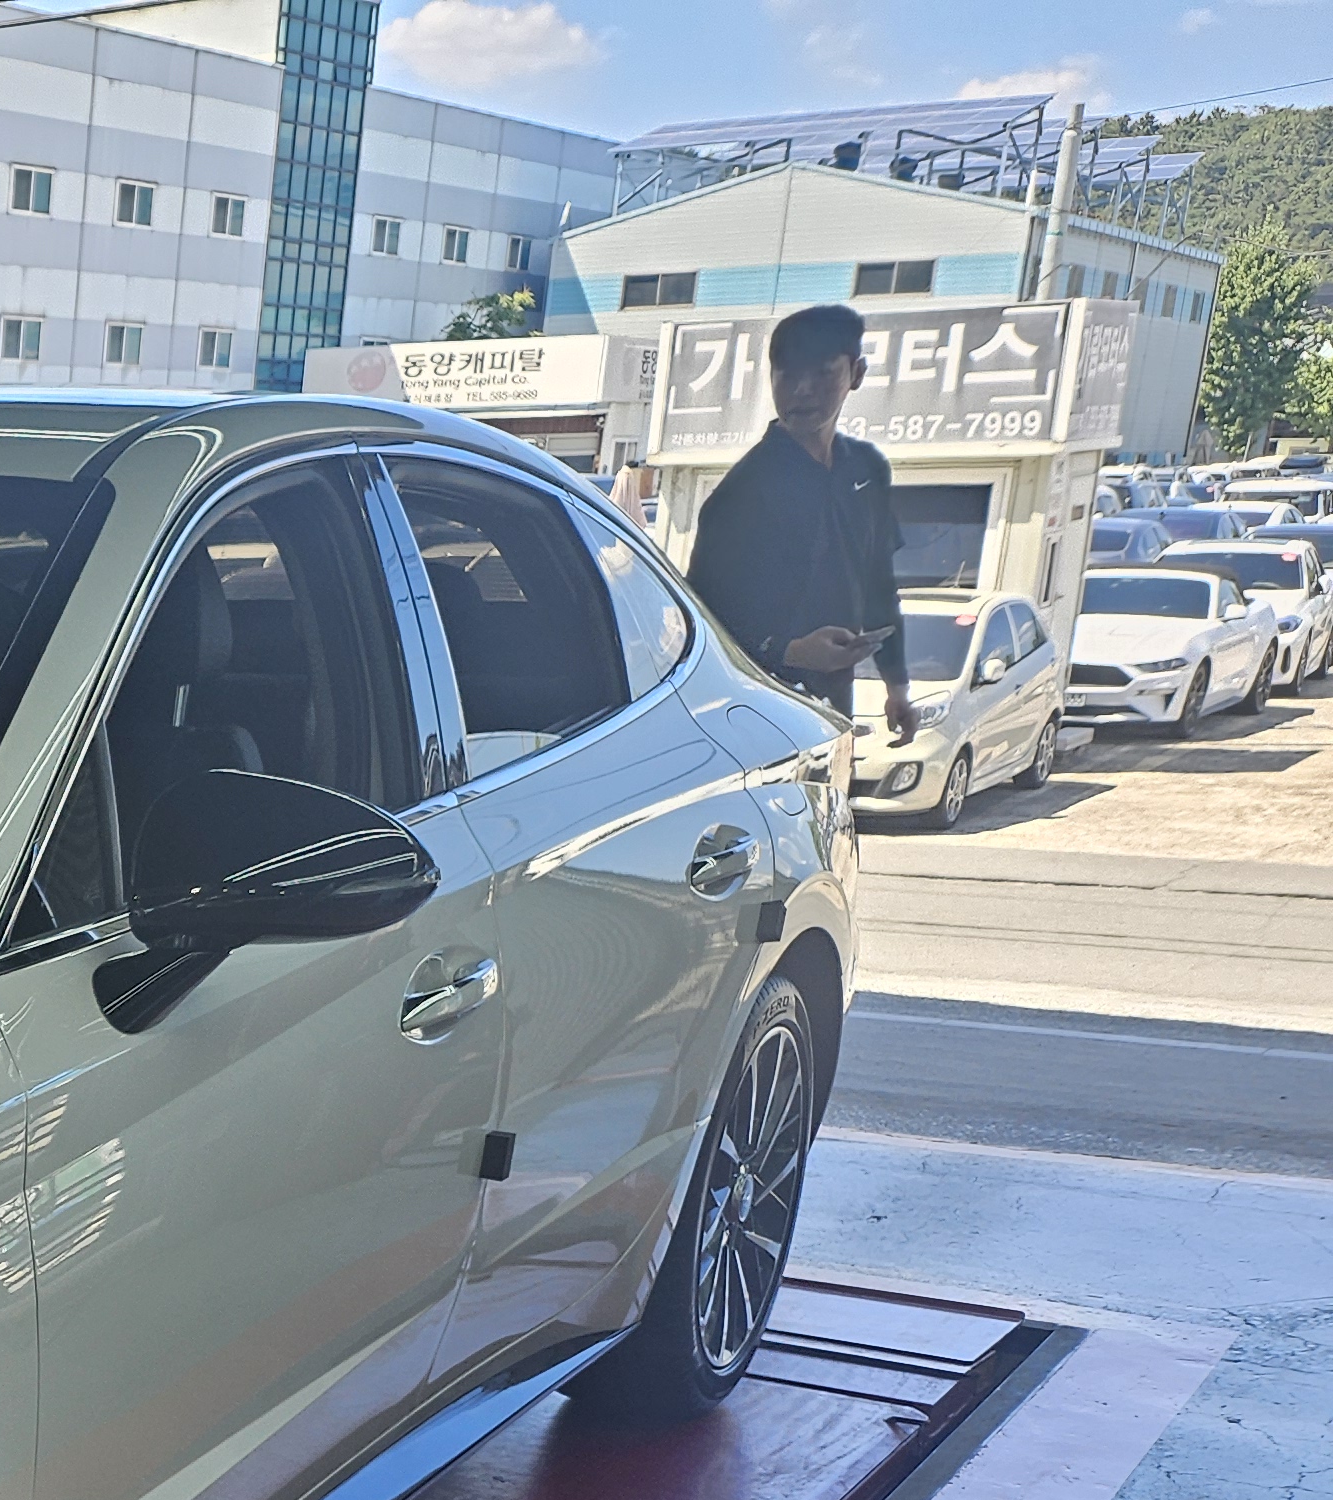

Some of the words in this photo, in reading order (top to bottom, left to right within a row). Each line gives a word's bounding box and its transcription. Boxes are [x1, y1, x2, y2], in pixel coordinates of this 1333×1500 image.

[401, 348, 545, 378] 동양캐피탈
[689, 322, 1040, 401] 가모터스
[432, 377, 461, 391] Yang
[464, 373, 508, 389] Capital
[837, 408, 1043, 442] 53-587-7999
